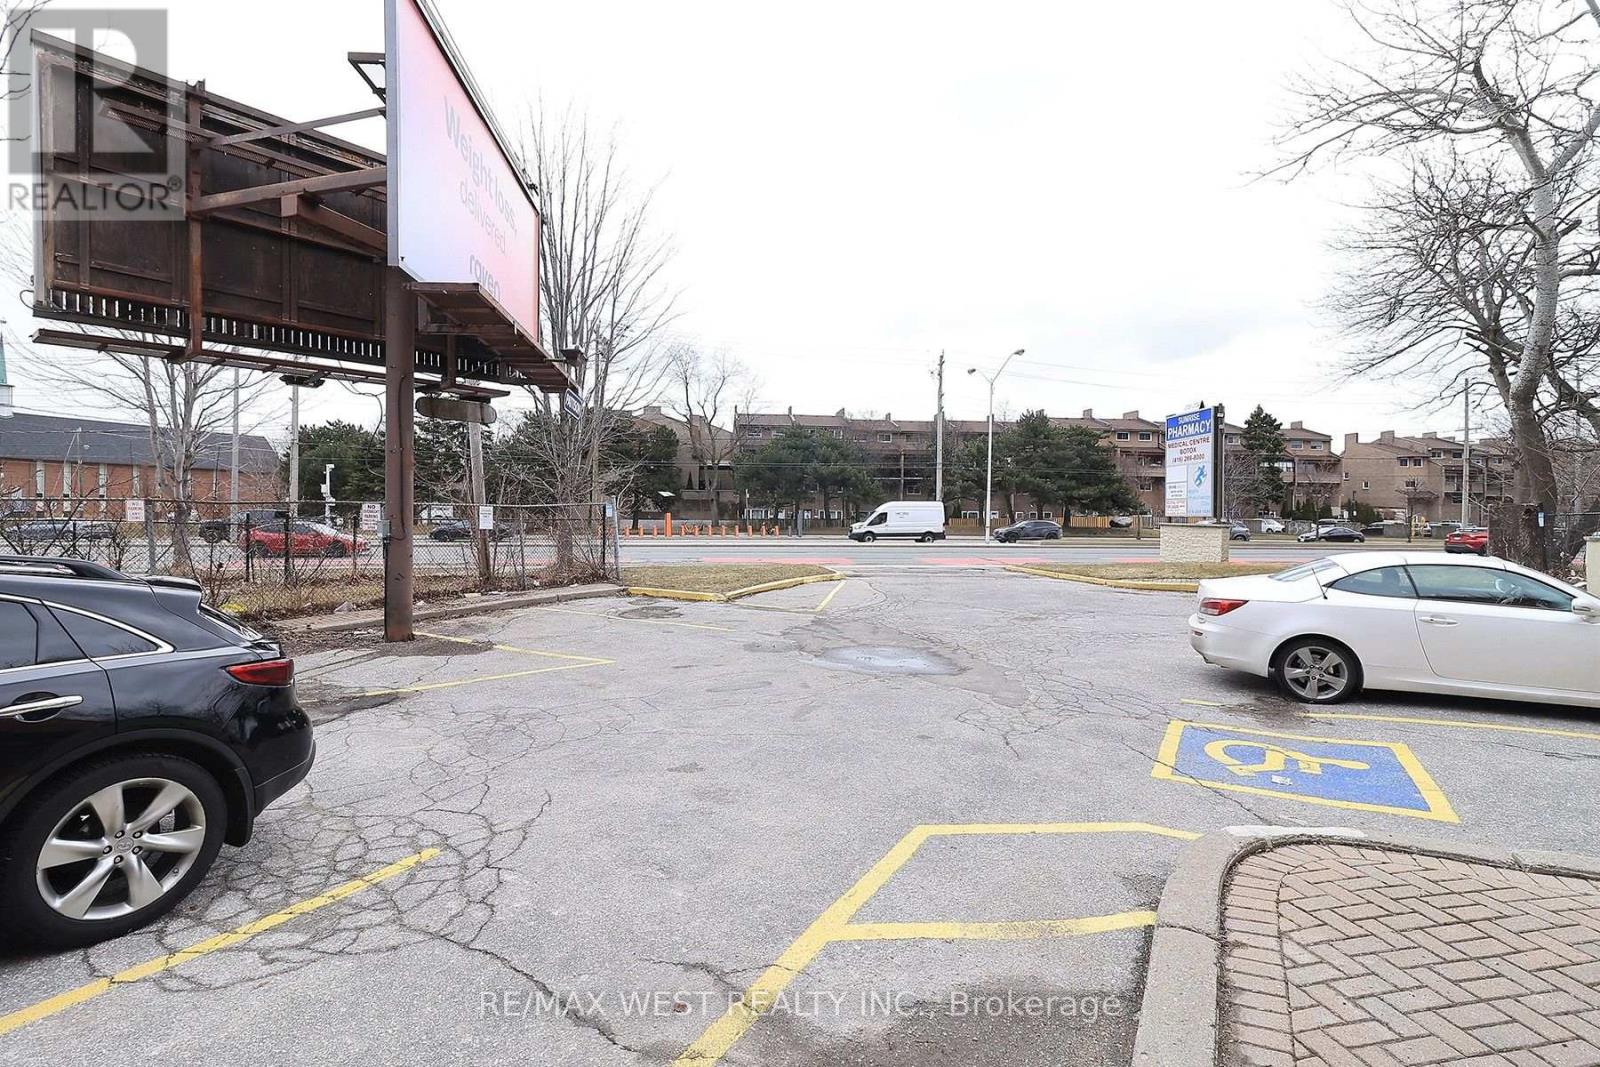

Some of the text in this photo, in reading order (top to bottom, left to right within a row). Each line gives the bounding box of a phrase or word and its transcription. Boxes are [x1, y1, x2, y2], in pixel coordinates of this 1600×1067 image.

[443, 95, 494, 197] Weight
[469, 254, 501, 302] raven
[1178, 413, 1200, 423] SUNRISE
[1167, 419, 1211, 439] PHARMACY
[1168, 437, 1210, 449] MEDICAL CENTRE
